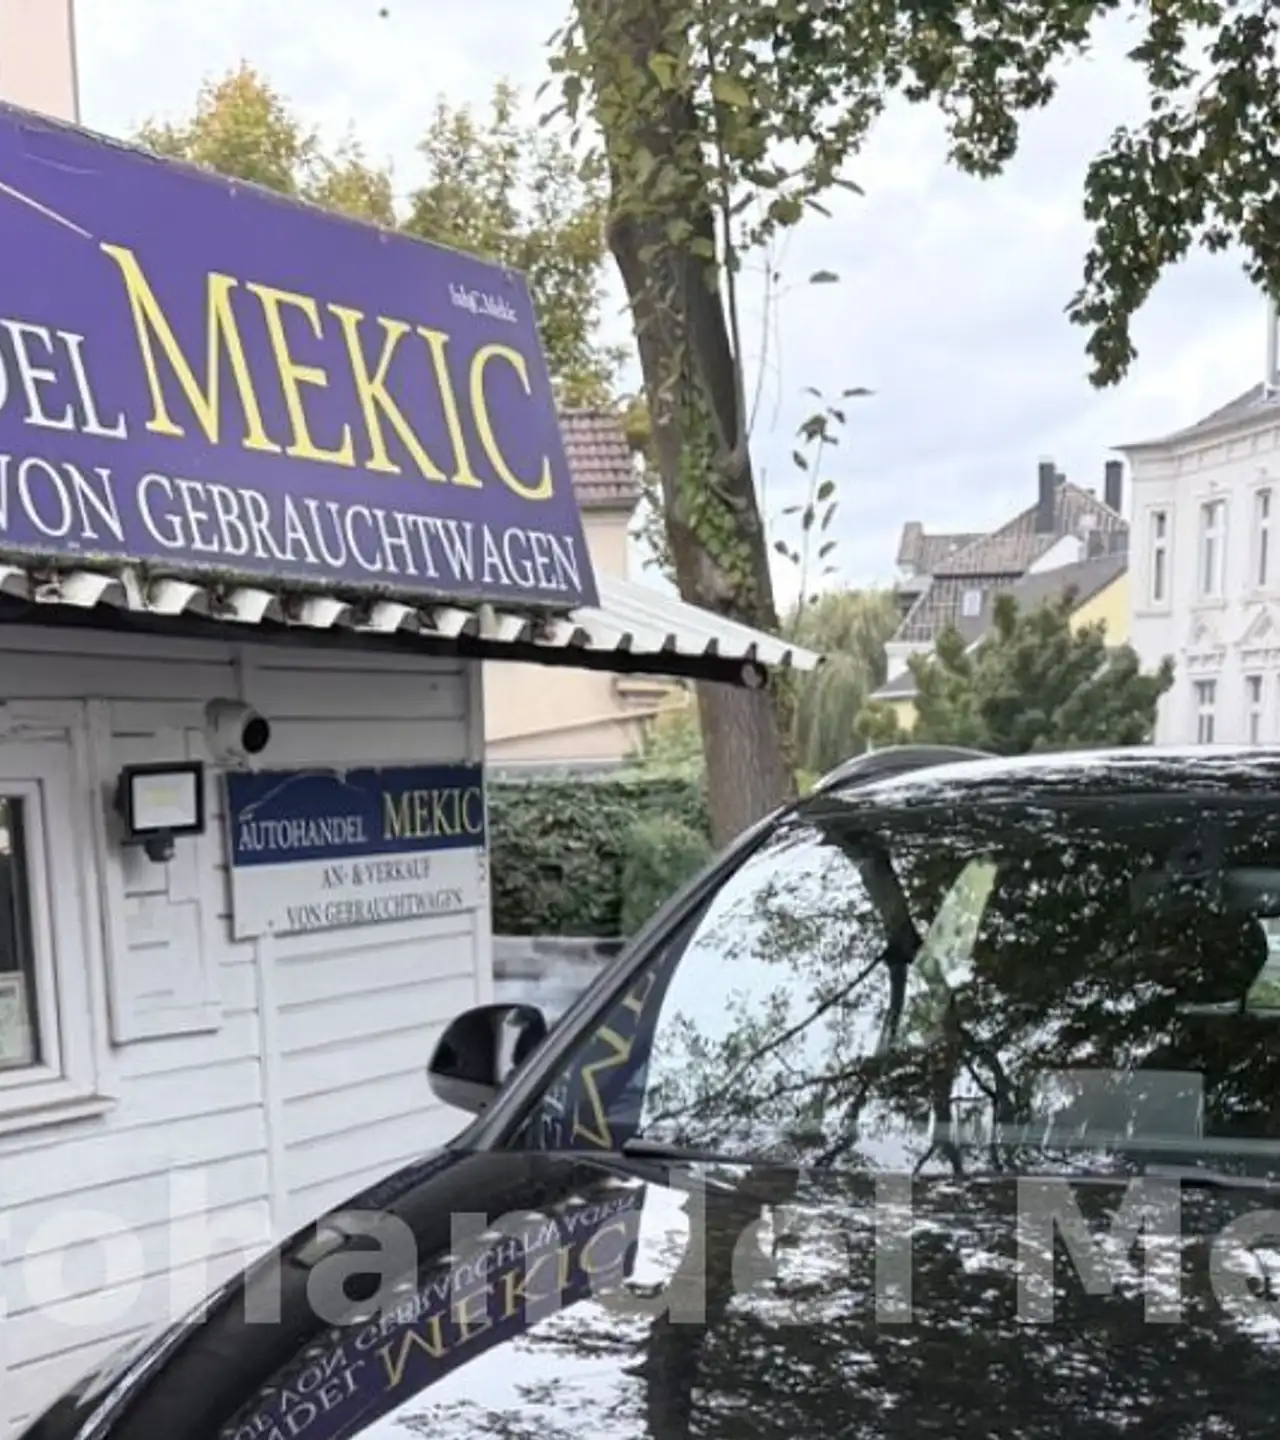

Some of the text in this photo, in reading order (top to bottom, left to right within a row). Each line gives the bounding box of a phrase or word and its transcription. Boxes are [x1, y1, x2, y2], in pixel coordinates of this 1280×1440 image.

[100, 243, 554, 500] MEKIC
[138, 471, 583, 594] GEBRAUCHTWAGEN
[239, 787, 483, 850] AUTOHANDEL MEKIC
[367, 857, 431, 883] VERKAUF
[287, 889, 464, 930] VON GEBRAUCHTWAGEN
